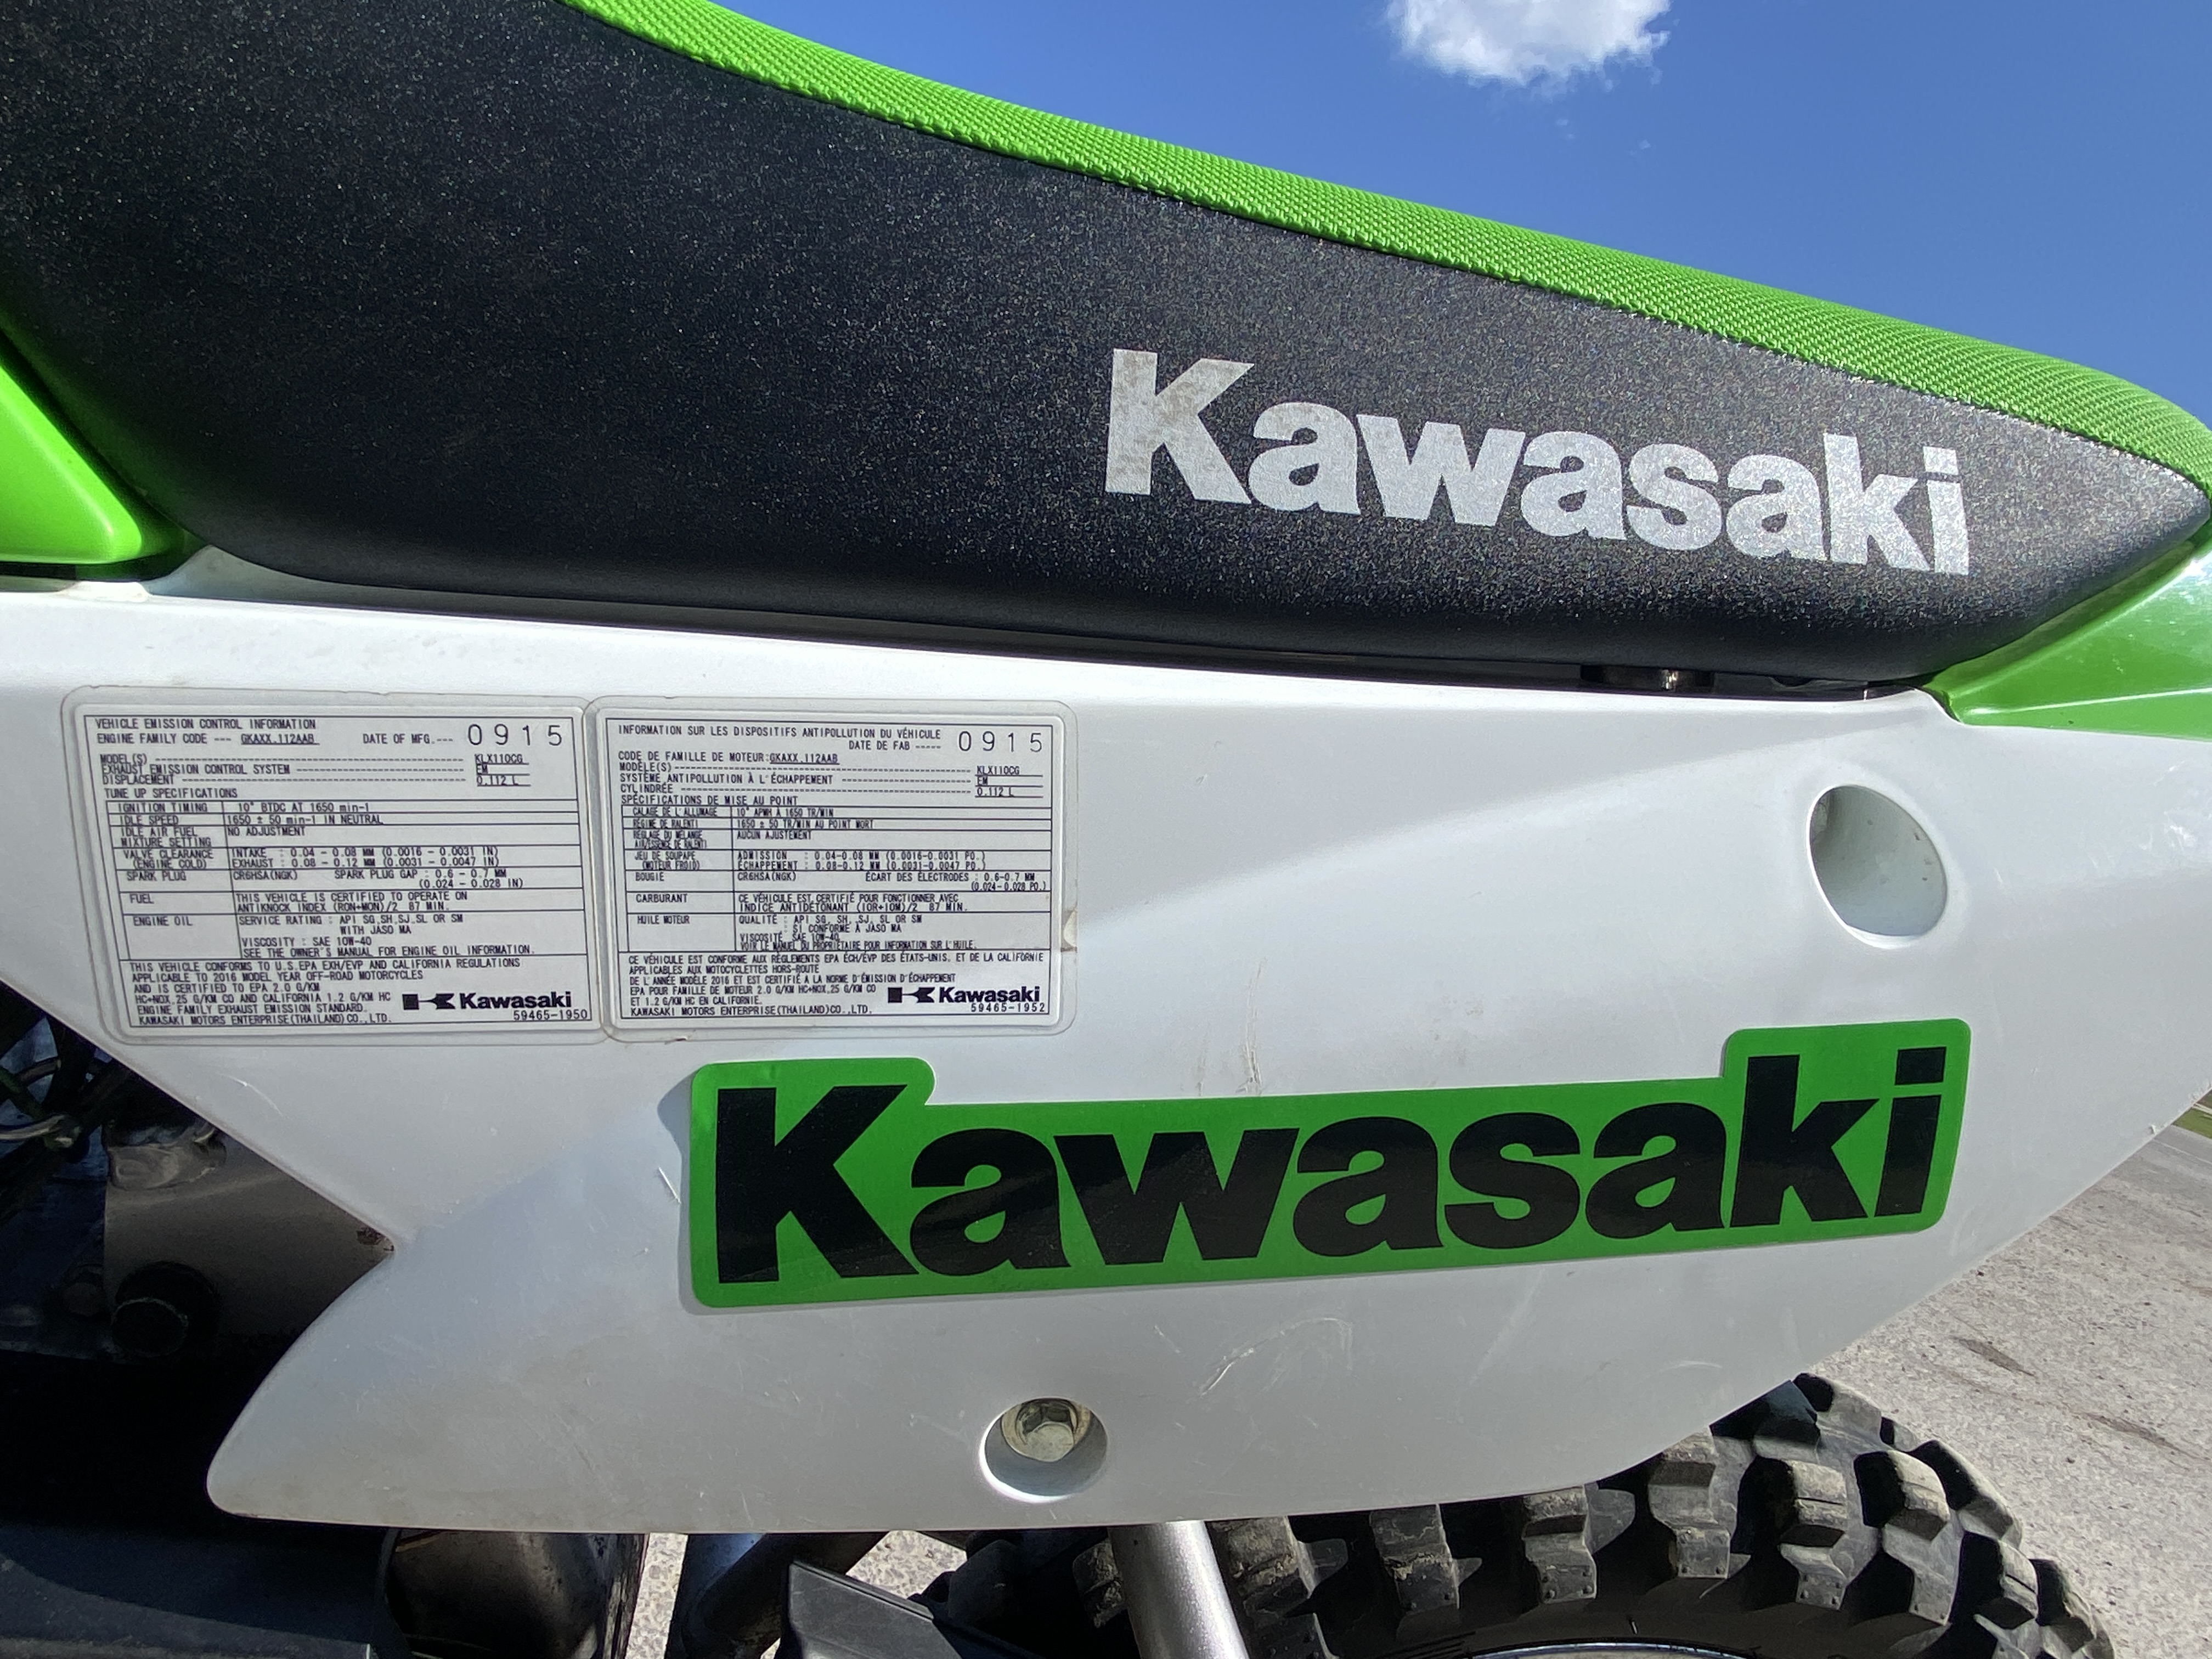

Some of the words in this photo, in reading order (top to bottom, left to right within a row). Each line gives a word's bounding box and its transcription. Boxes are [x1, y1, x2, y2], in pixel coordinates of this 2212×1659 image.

[1104, 348, 1970, 576] Kawasaki
[95, 719, 139, 729] VEHICLE
[144, 719, 194, 729] EMISSION
[199, 719, 242, 729] CONTROL
[250, 719, 316, 729] INFORMATION
[618, 725, 682, 736] INFORMATION
[687, 726, 705, 736] SUR
[710, 726, 728, 736] LES
[733, 727, 797, 737] DISPOSITIFS
[802, 728, 875, 738] ANTIPOLLUTION
[881, 729, 892, 739] DU
[97, 733, 136, 744] ENGINE
[139, 733, 177, 744] FAMILY
[183, 733, 207, 744] CODE
[363, 733, 388, 744] DATE
[393, 734, 405, 744] OF
[849, 741, 871, 750] DATE
[877, 741, 888, 750] DE
[894, 741, 910, 750] FAB
[100, 754, 148, 765] MODEL(S)
[618, 752, 642, 761] CODE
[648, 752, 659, 761] DE
[665, 752, 707, 762] FAMILLE
[712, 752, 724, 762] DE
[101, 765, 143, 774] EXHAUST
[150, 765, 199, 774] EMISSION
[205, 765, 247, 774] CONTROL
[253, 765, 290, 774] SYSTEM
[102, 775, 174, 785] DISPLACEMENT
[620, 771, 661, 783] SYSTÈME
[667, 774, 743, 784] ANTIPOLLUTION
[104, 788, 129, 798] TUNE
[134, 788, 146, 798] UP
[153, 788, 238, 798] SPECIFICATIONS
[707, 795, 719, 805] DE
[724, 796, 747, 805] MISE
[753, 796, 764, 805] AU
[770, 796, 798, 806] POINT
[119, 803, 165, 812] IGNITION
[171, 803, 207, 812] TIMING
[261, 803, 286, 812] BTDC
[292, 803, 303, 812] AT
[311, 803, 334, 811] 1650
[120, 815, 143, 824] IDLE
[149, 816, 179, 824] SPEED
[227, 815, 251, 823] 1650
[269, 815, 281, 823] 50
[120, 827, 144, 836] IDLE
[150, 828, 168, 836] AIR
[174, 827, 198, 836] FUEL
[228, 827, 240, 836] NO
[247, 826, 306, 836] ADJUSTMENT
[121, 838, 162, 847] MIXTURE
[169, 838, 212, 847] SETTING
[127, 872, 157, 881] SPARK
[162, 872, 187, 881] PLUG
[335, 870, 364, 879] SPARK
[370, 869, 394, 879] PLUG
[400, 870, 417, 878] GAP
[130, 894, 154, 904] FUEL
[236, 893, 260, 902] THIS
[265, 893, 307, 902] VEHICLE
[315, 893, 325, 901] IS
[331, 892, 385, 901] CERTIFIED
[391, 892, 403, 901] TO
[408, 892, 450, 901] OPERATE
[455, 891, 467, 900] ON
[636, 894, 687, 903] CARBURANT
[237, 903, 291, 912] ANTIKNOCK
[297, 903, 326, 912] INDEX
[133, 917, 169, 926] ENGINE
[174, 917, 193, 926] OIL
[239, 916, 280, 925] SERVICE
[286, 916, 322, 925] RATING
[433, 913, 445, 923] OR
[451, 913, 463, 923] SM
[340, 924, 364, 935] WITH
[370, 924, 394, 935] JASO
[399, 924, 411, 934] MA
[241, 938, 295, 947] VISCOSITY
[313, 937, 330, 946] SAE
[244, 948, 261, 958] SEE
[267, 948, 285, 957] THE
[337, 946, 373, 957] MANUAL
[379, 946, 396, 956] FOR
[402, 945, 437, 956] ENGINE
[442, 945, 461, 955] OIL
[131, 962, 153, 972] THIS
[158, 962, 199, 972] VEHICLE
[205, 962, 253, 971] CONFORMS
[258, 962, 270, 971] TO
[369, 960, 387, 969] AND
[392, 958, 452, 969] CALIFORNIA
[456, 957, 520, 968] REGULATIONS
[629, 966, 682, 974] APPLICABLES
[687, 966, 702, 974] AUX
[706, 965, 768, 974] MOTOCYCLETTES
[772, 964, 820, 974] HORS-ROUTE
[132, 973, 190, 983] APPLICABLE
[196, 973, 207, 982] TO
[213, 973, 237, 981] 2016
[242, 972, 272, 981] MODEL
[277, 972, 301, 981] YEAR
[306, 970, 353, 981] OFF-ROAD
[359, 970, 424, 980] MOTORCYCLES
[939, 986, 1040, 1003] Kawasaki
[460, 991, 571, 1009] Kawasaki
[630, 1007, 675, 1016] KAWASAKI
[681, 1007, 715, 1015] MOTORS
[717, 1047, 1946, 1283] Kawasaki
